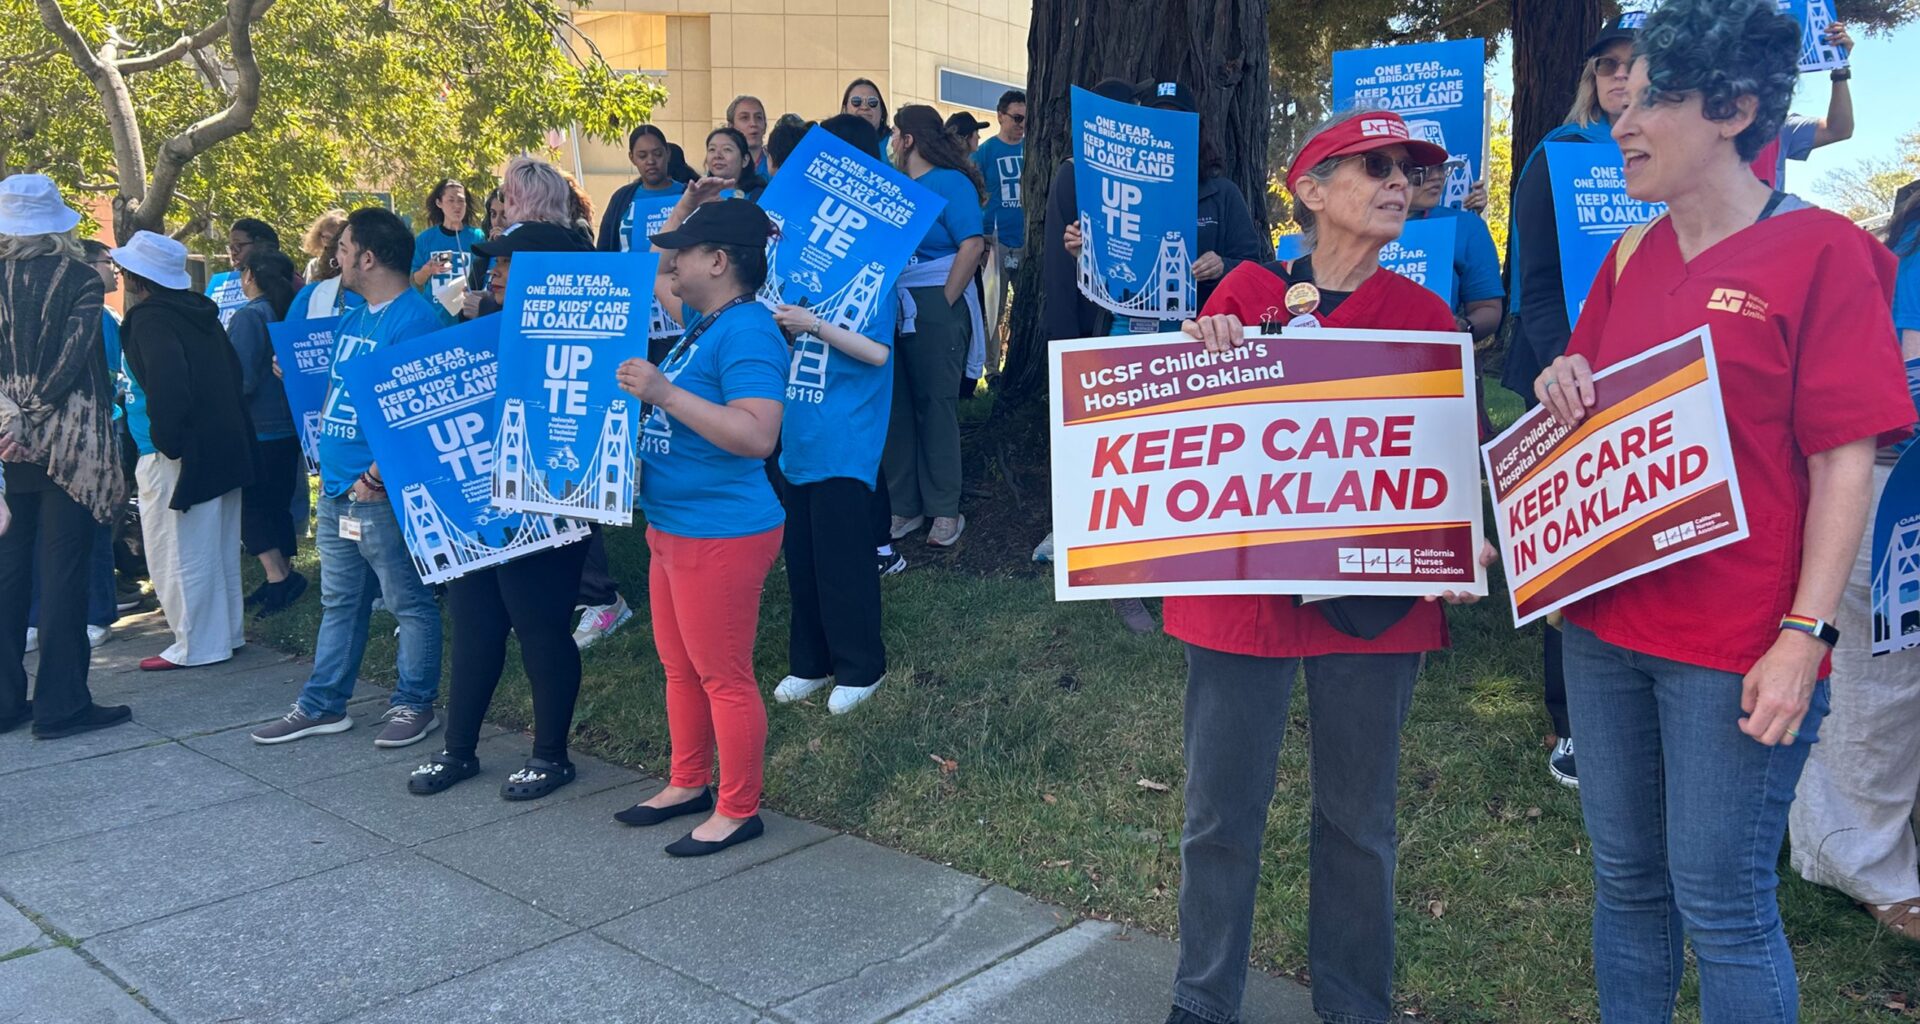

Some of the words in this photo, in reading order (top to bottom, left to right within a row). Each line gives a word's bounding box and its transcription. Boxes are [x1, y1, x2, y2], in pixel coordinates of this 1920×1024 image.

[1356, 77, 1376, 86] ONE
[1378, 73, 1415, 84] BRIDGE
[1418, 71, 1438, 80] TOO
[1440, 68, 1462, 78] FAR.
[1374, 65, 1402, 77] ONE
[1405, 61, 1444, 73] YEAR.
[1158, 88, 1176, 96] TE
[1355, 87, 1388, 100] KEEP
[1392, 84, 1425, 96] KIDS'
[1428, 80, 1463, 92] CARE
[1377, 91, 1463, 110] OAKLAND
[1083, 120, 1097, 132] ONE
[1098, 128, 1126, 142] BRIDGE
[1129, 135, 1148, 146] TOO
[1151, 140, 1174, 149] FAR.
[1096, 115, 1116, 131] ONE
[1118, 121, 1154, 139] YEAR.
[1424, 126, 1438, 137] UP
[1083, 131, 1105, 148] KEEP
[1107, 141, 1135, 157] KIDS'
[1139, 150, 1175, 164] CARE
[1083, 142, 1095, 159] IN
[1097, 149, 1174, 177] OAKLAND
[820, 152, 840, 166] ONE
[840, 164, 874, 186] BRIDGE
[876, 180, 895, 197] TOO
[896, 194, 916, 210] FAR.
[841, 156, 868, 173] ONE
[869, 171, 902, 196] YEAR.
[1574, 179, 1595, 188] ONE
[1590, 166, 1618, 179] ONE
[806, 164, 828, 180] IN
[828, 176, 909, 225] OAKLAND
[812, 157, 845, 178] KEEP
[846, 176, 880, 197] KIDS'
[880, 196, 913, 219] CARE
[1102, 177, 1142, 211] UP
[1575, 194, 1608, 206] KEEP
[818, 195, 868, 231] UP
[1101, 205, 1141, 242] TE
[1577, 207, 1596, 222] IN
[1600, 206, 1670, 222] OAKLAN
[810, 215, 856, 259] TE
[1166, 231, 1181, 240] SF
[870, 261, 886, 272] SF
[1379, 252, 1397, 261] OO
[1400, 250, 1427, 259] FAR.
[527, 286, 546, 295] ONE
[548, 286, 584, 296] BRIDGE
[586, 287, 606, 296] TOO
[608, 288, 631, 297] FAR.
[546, 274, 573, 286] ONE
[576, 275, 613, 287] YEAR.
[523, 300, 556, 311] KEEP
[558, 300, 592, 312] KIDS'
[595, 301, 630, 314] CARE
[521, 312, 539, 327] IN
[543, 312, 628, 330] OAKLAND
[293, 341, 312, 349] ONE
[308, 331, 332, 340] ONE
[295, 348, 325, 358] KEEP
[297, 358, 316, 369] IN
[392, 360, 424, 378] ONE
[424, 347, 470, 366] YEAR.
[546, 344, 592, 379] UP
[374, 379, 399, 393] ONE
[400, 366, 441, 385] BRIDGE
[443, 358, 466, 371] TOO
[468, 350, 494, 364] FAR.
[1080, 362, 1143, 390] UCSF
[1149, 341, 1268, 376] Children's
[378, 388, 416, 408] KEEP
[419, 374, 456, 396] KIDS'
[382, 404, 406, 422] IN
[409, 374, 497, 413] OAKLAN
[544, 379, 589, 416] TE
[1083, 377, 1180, 412] Hospital
[1186, 360, 1284, 391] Oakland
[611, 400, 626, 410] SF
[327, 423, 356, 440] 9119
[427, 412, 484, 453] UP
[1091, 423, 1246, 478] KEEP
[1261, 415, 1415, 462] CARE
[1496, 447, 1519, 476] UCSF
[1520, 415, 1556, 452] Childre
[438, 440, 492, 481] TE
[1499, 450, 1536, 491] Hospital
[1536, 425, 1572, 456] Oaklan
[1509, 470, 1569, 537] KEEP
[1575, 410, 1673, 488] CARE
[405, 483, 419, 491] OAK
[1088, 484, 1150, 532] IN
[1166, 467, 1449, 523] OAKLAND
[1514, 534, 1537, 576] IN
[1542, 445, 1708, 554] OAKLAND
[1695, 512, 1721, 524] California
[1698, 521, 1729, 535] Association
[1414, 549, 1455, 557] California
